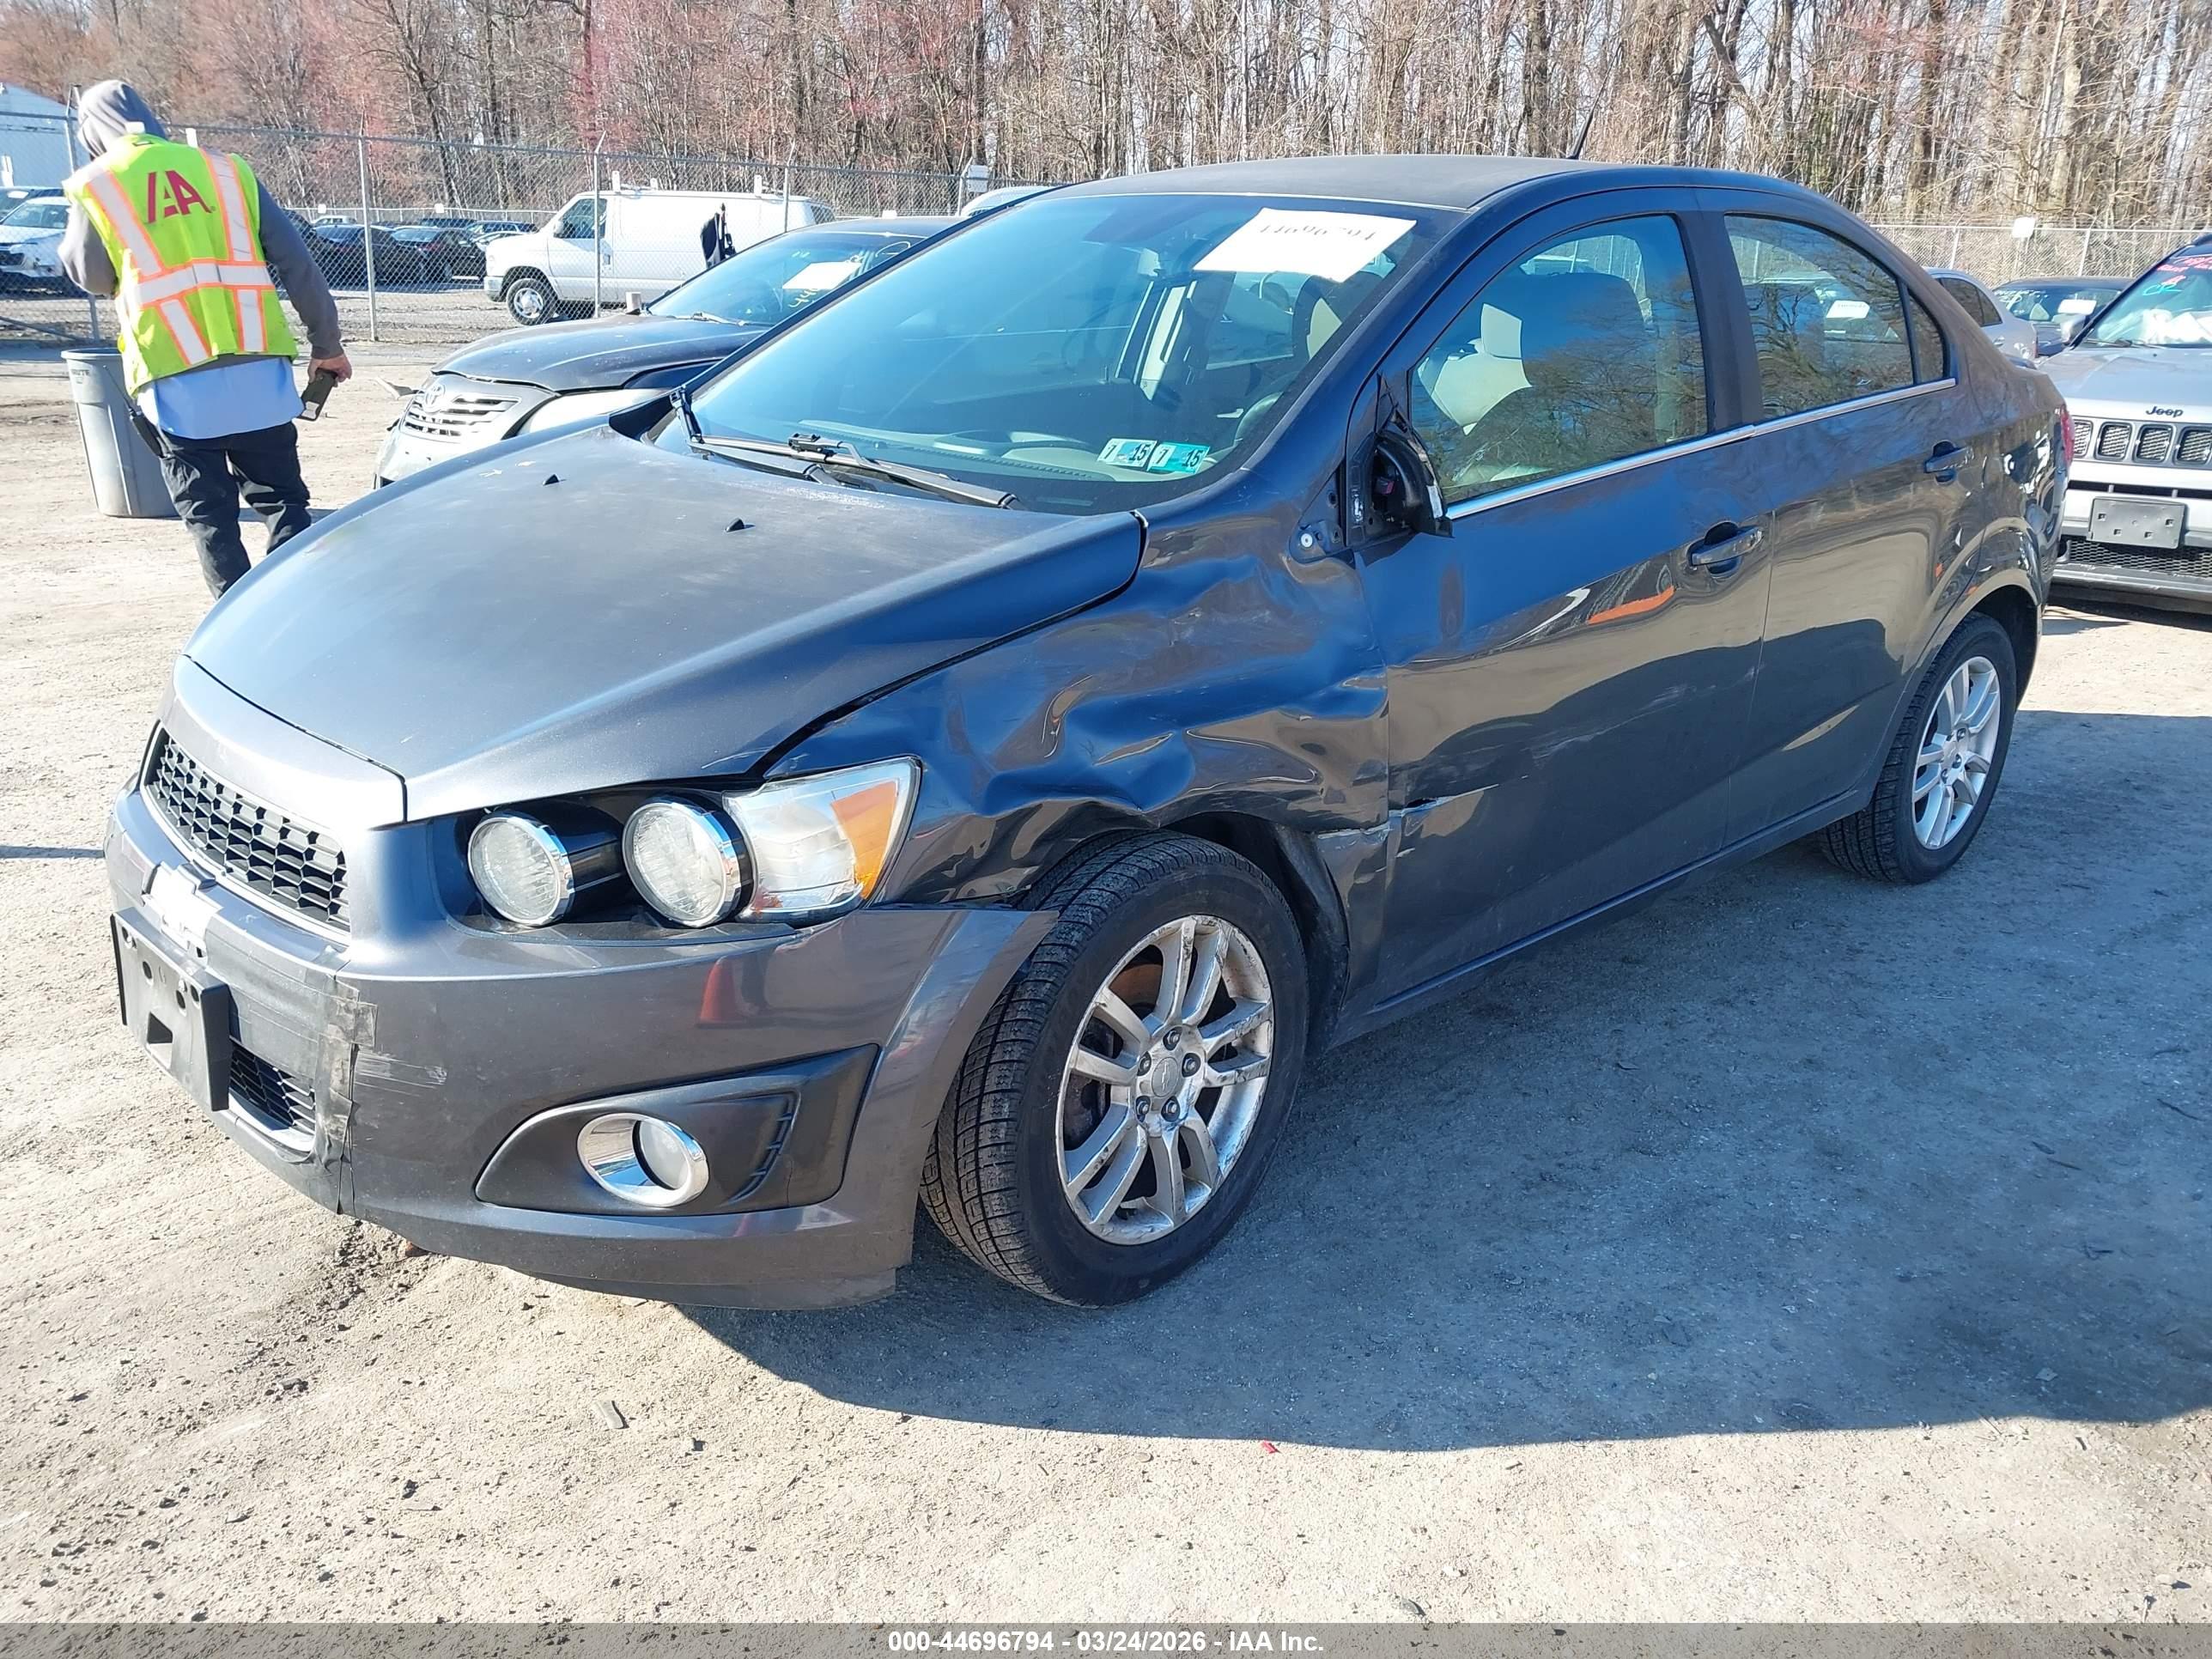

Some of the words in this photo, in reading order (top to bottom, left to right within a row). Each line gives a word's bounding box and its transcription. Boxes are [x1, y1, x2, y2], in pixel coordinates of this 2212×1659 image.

[2145, 405, 2184, 418] Jeep
[1103, 445, 1117, 459] 7
[1128, 443, 1151, 461] 15
[1156, 448, 1169, 465] 7
[1182, 449, 1204, 467] 15
